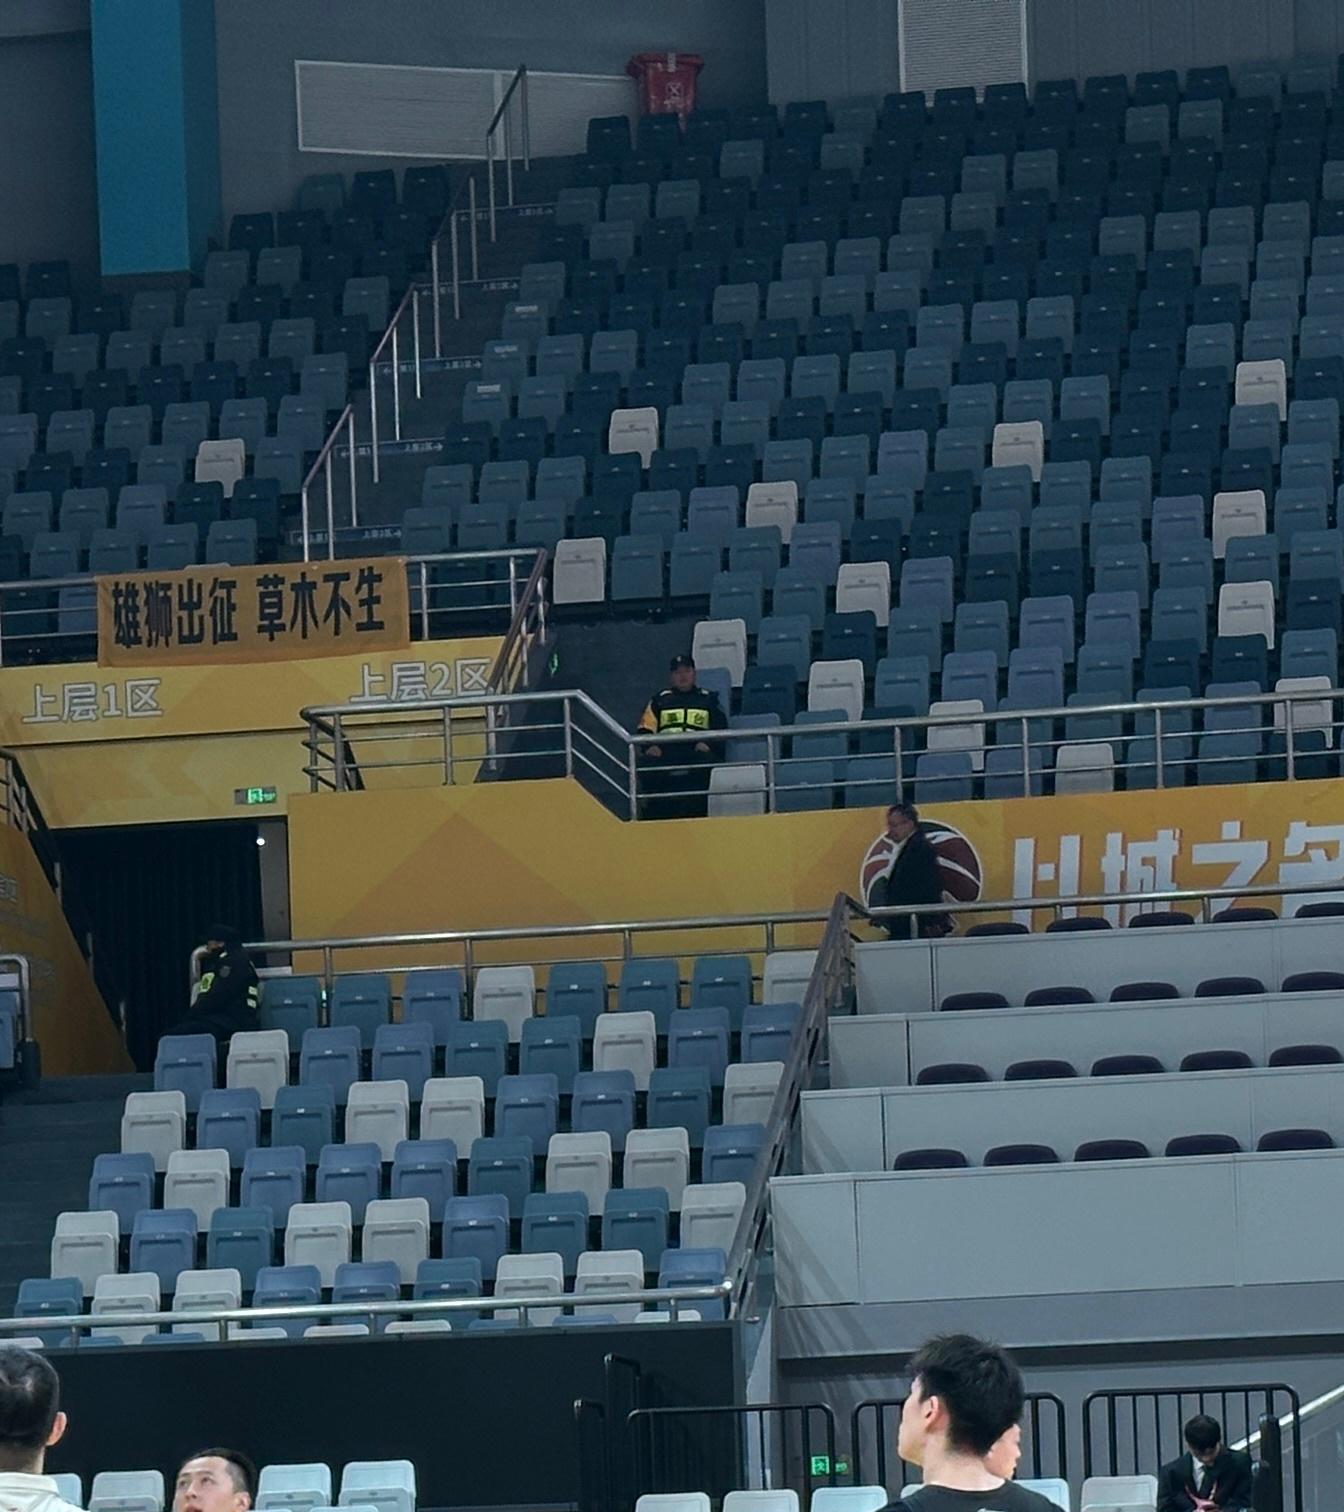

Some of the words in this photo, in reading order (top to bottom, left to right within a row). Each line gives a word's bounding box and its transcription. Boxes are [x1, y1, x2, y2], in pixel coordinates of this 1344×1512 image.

[111, 576, 239, 650] 雄狮出征
[256, 566, 385, 643] 草木不生
[22, 677, 164, 724] 上层1区
[349, 656, 492, 702] 上层2区
